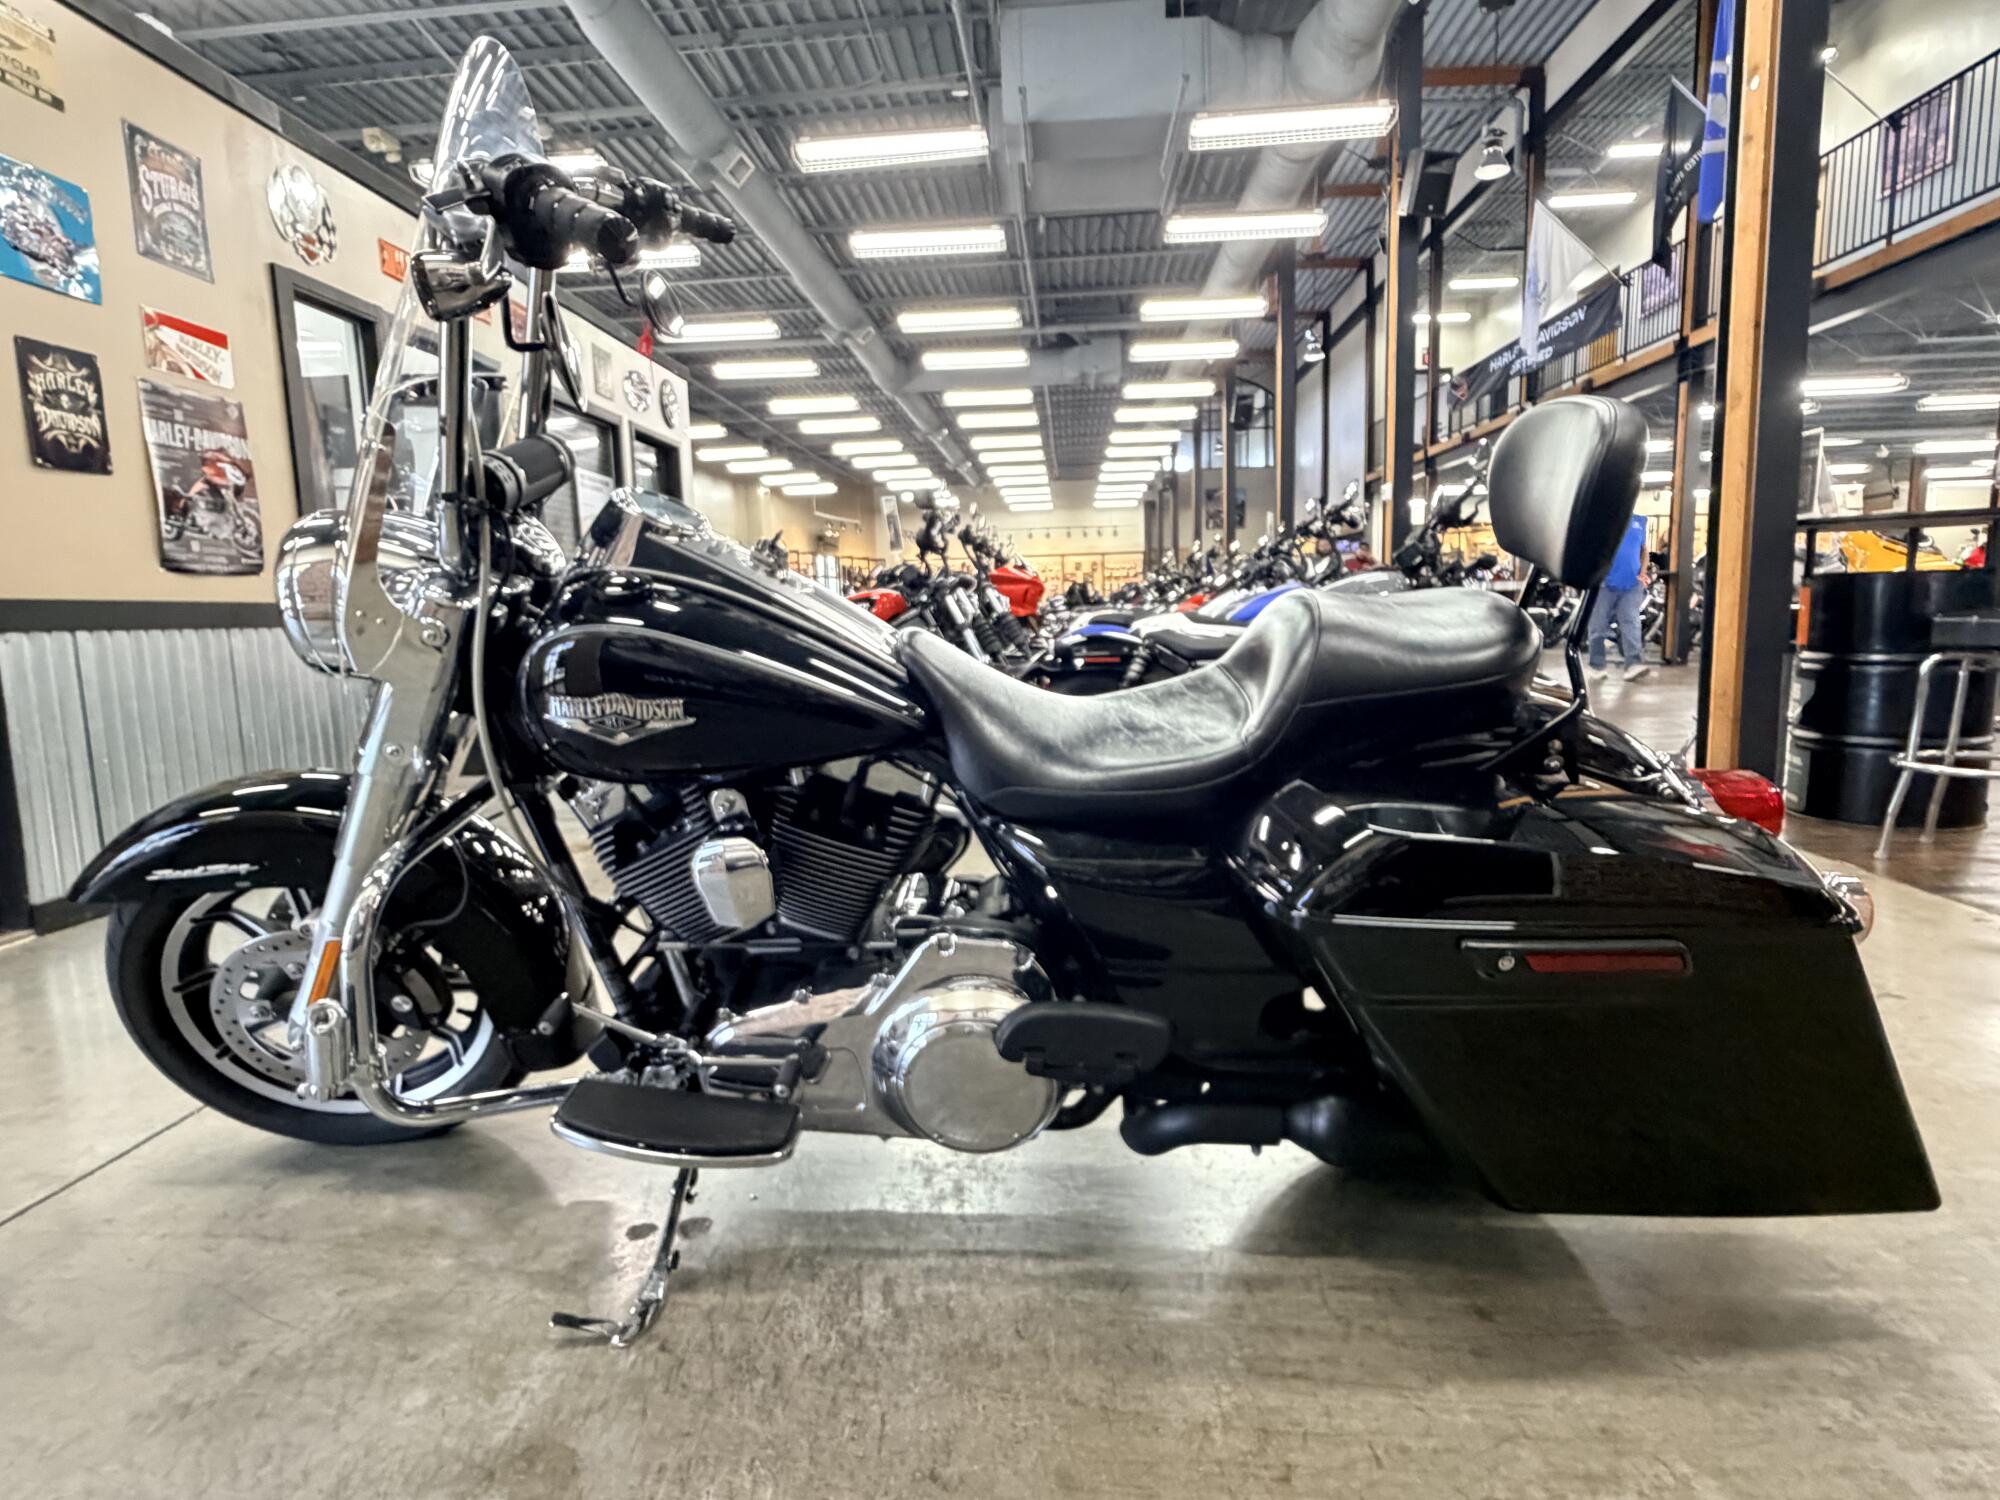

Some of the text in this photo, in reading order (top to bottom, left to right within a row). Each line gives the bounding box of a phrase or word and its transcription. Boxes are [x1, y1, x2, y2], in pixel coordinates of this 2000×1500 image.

[138, 163, 200, 213] STURGIS
[27, 370, 98, 407] HARLEY
[33, 401, 102, 440] DAVIDSON
